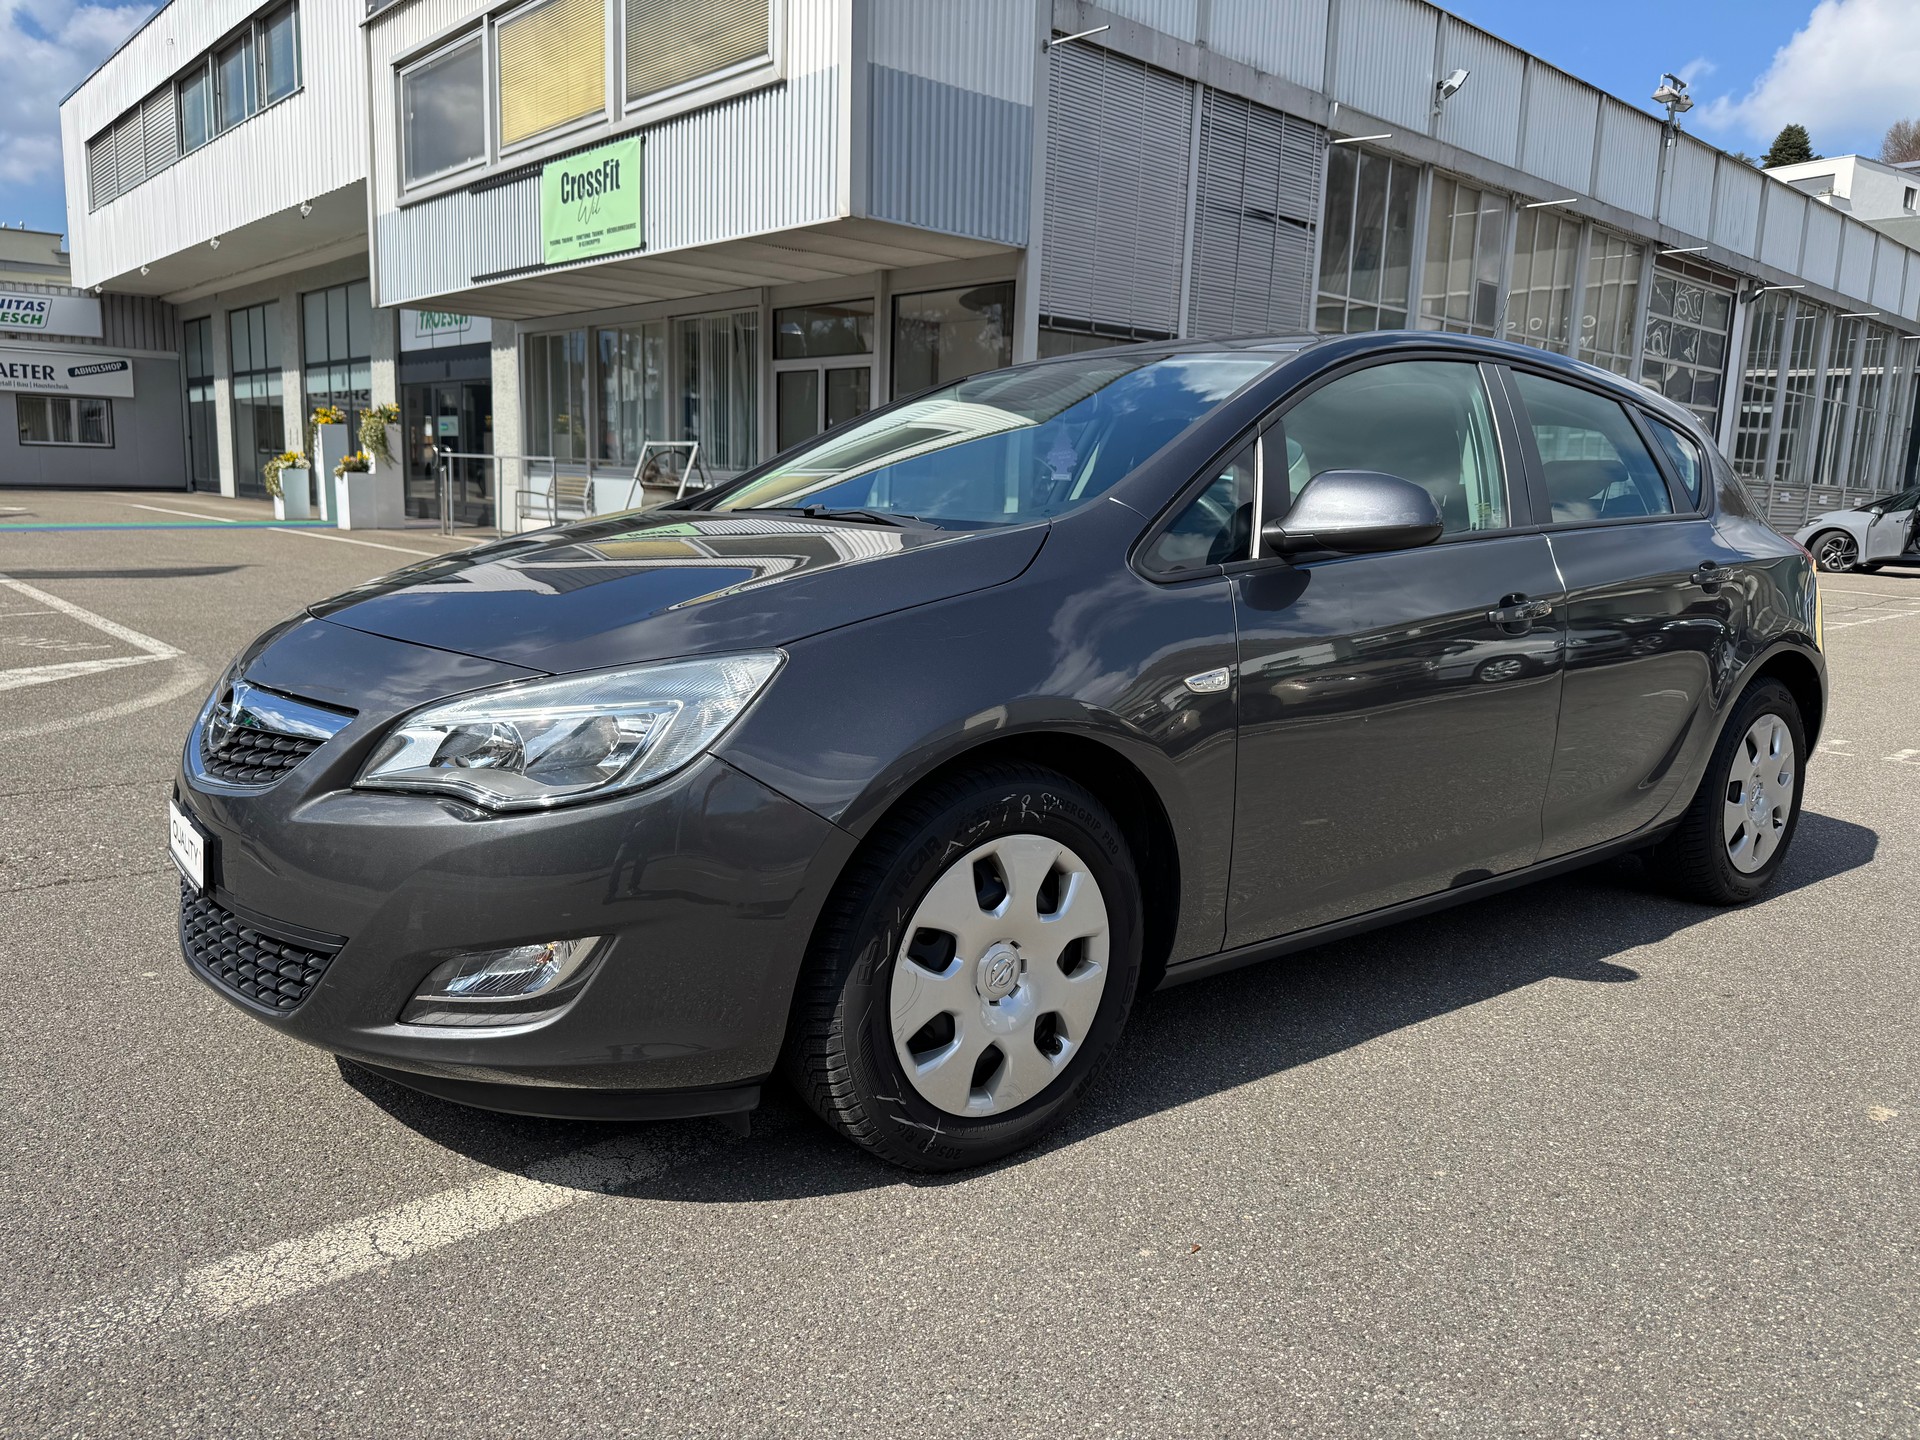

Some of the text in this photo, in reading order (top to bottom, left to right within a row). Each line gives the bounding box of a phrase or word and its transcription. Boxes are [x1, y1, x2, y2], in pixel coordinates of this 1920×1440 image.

[561, 159, 620, 204] CrossFit
[0, 312, 43, 325] ESCH
[74, 362, 122, 376] ABHOLSHOP
[1102, 830, 1120, 856] PRO
[888, 835, 943, 899] TECAR
